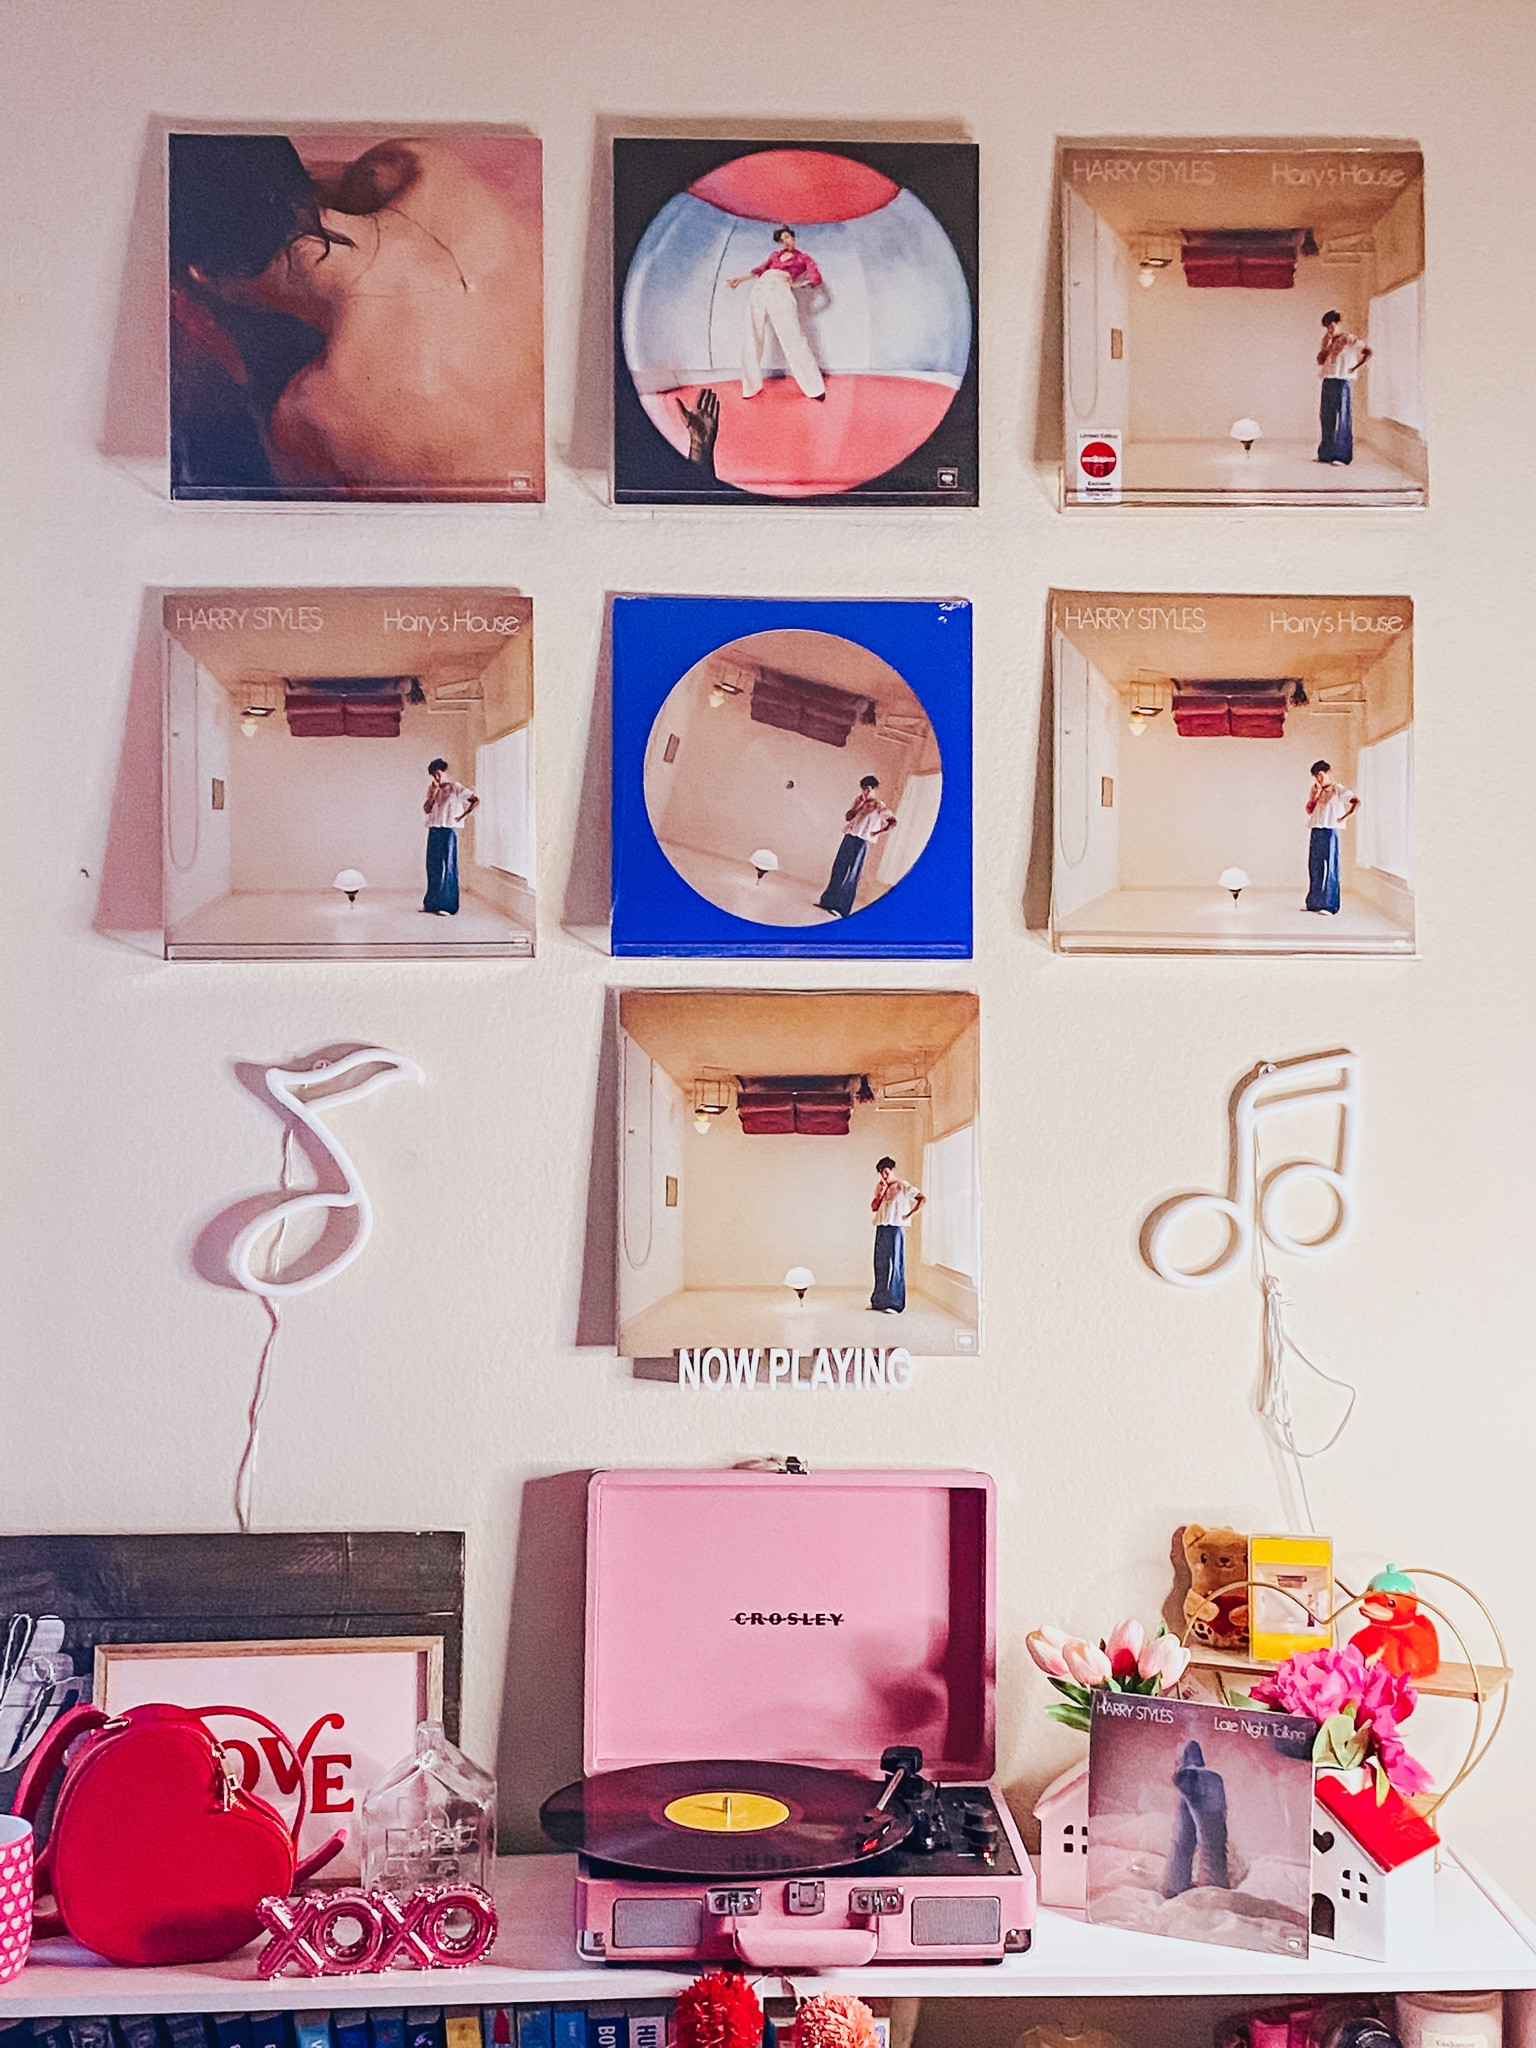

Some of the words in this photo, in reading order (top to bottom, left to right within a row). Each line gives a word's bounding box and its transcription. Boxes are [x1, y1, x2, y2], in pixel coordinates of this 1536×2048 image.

[1072, 158, 1141, 183] HARRY
[1147, 159, 1216, 185] STYLES
[1272, 162, 1338, 188] Harry's
[1340, 163, 1407, 188] House
[176, 606, 250, 631] HARRY
[252, 606, 324, 632] STYLES
[384, 608, 450, 638] Harry's
[452, 609, 521, 636] House
[1064, 606, 1135, 631] HARRY
[1137, 606, 1207, 634] STYLES
[1269, 609, 1334, 639] Harry's
[1337, 611, 1404, 636] House
[677, 1347, 762, 1391] NOW
[768, 1346, 914, 1391] PLAYING
[731, 1612, 845, 1626] CROSLEY
[1095, 1698, 1135, 1718] HARRY
[1135, 1705, 1175, 1724] STYLES
[1213, 1716, 1240, 1733] Late
[1240, 1719, 1269, 1739] Night
[1270, 1722, 1307, 1745] Talking
[216, 1712, 355, 1814] OVE
[256, 1882, 499, 1980] XOXO
[636, 2024, 657, 2048] HU
